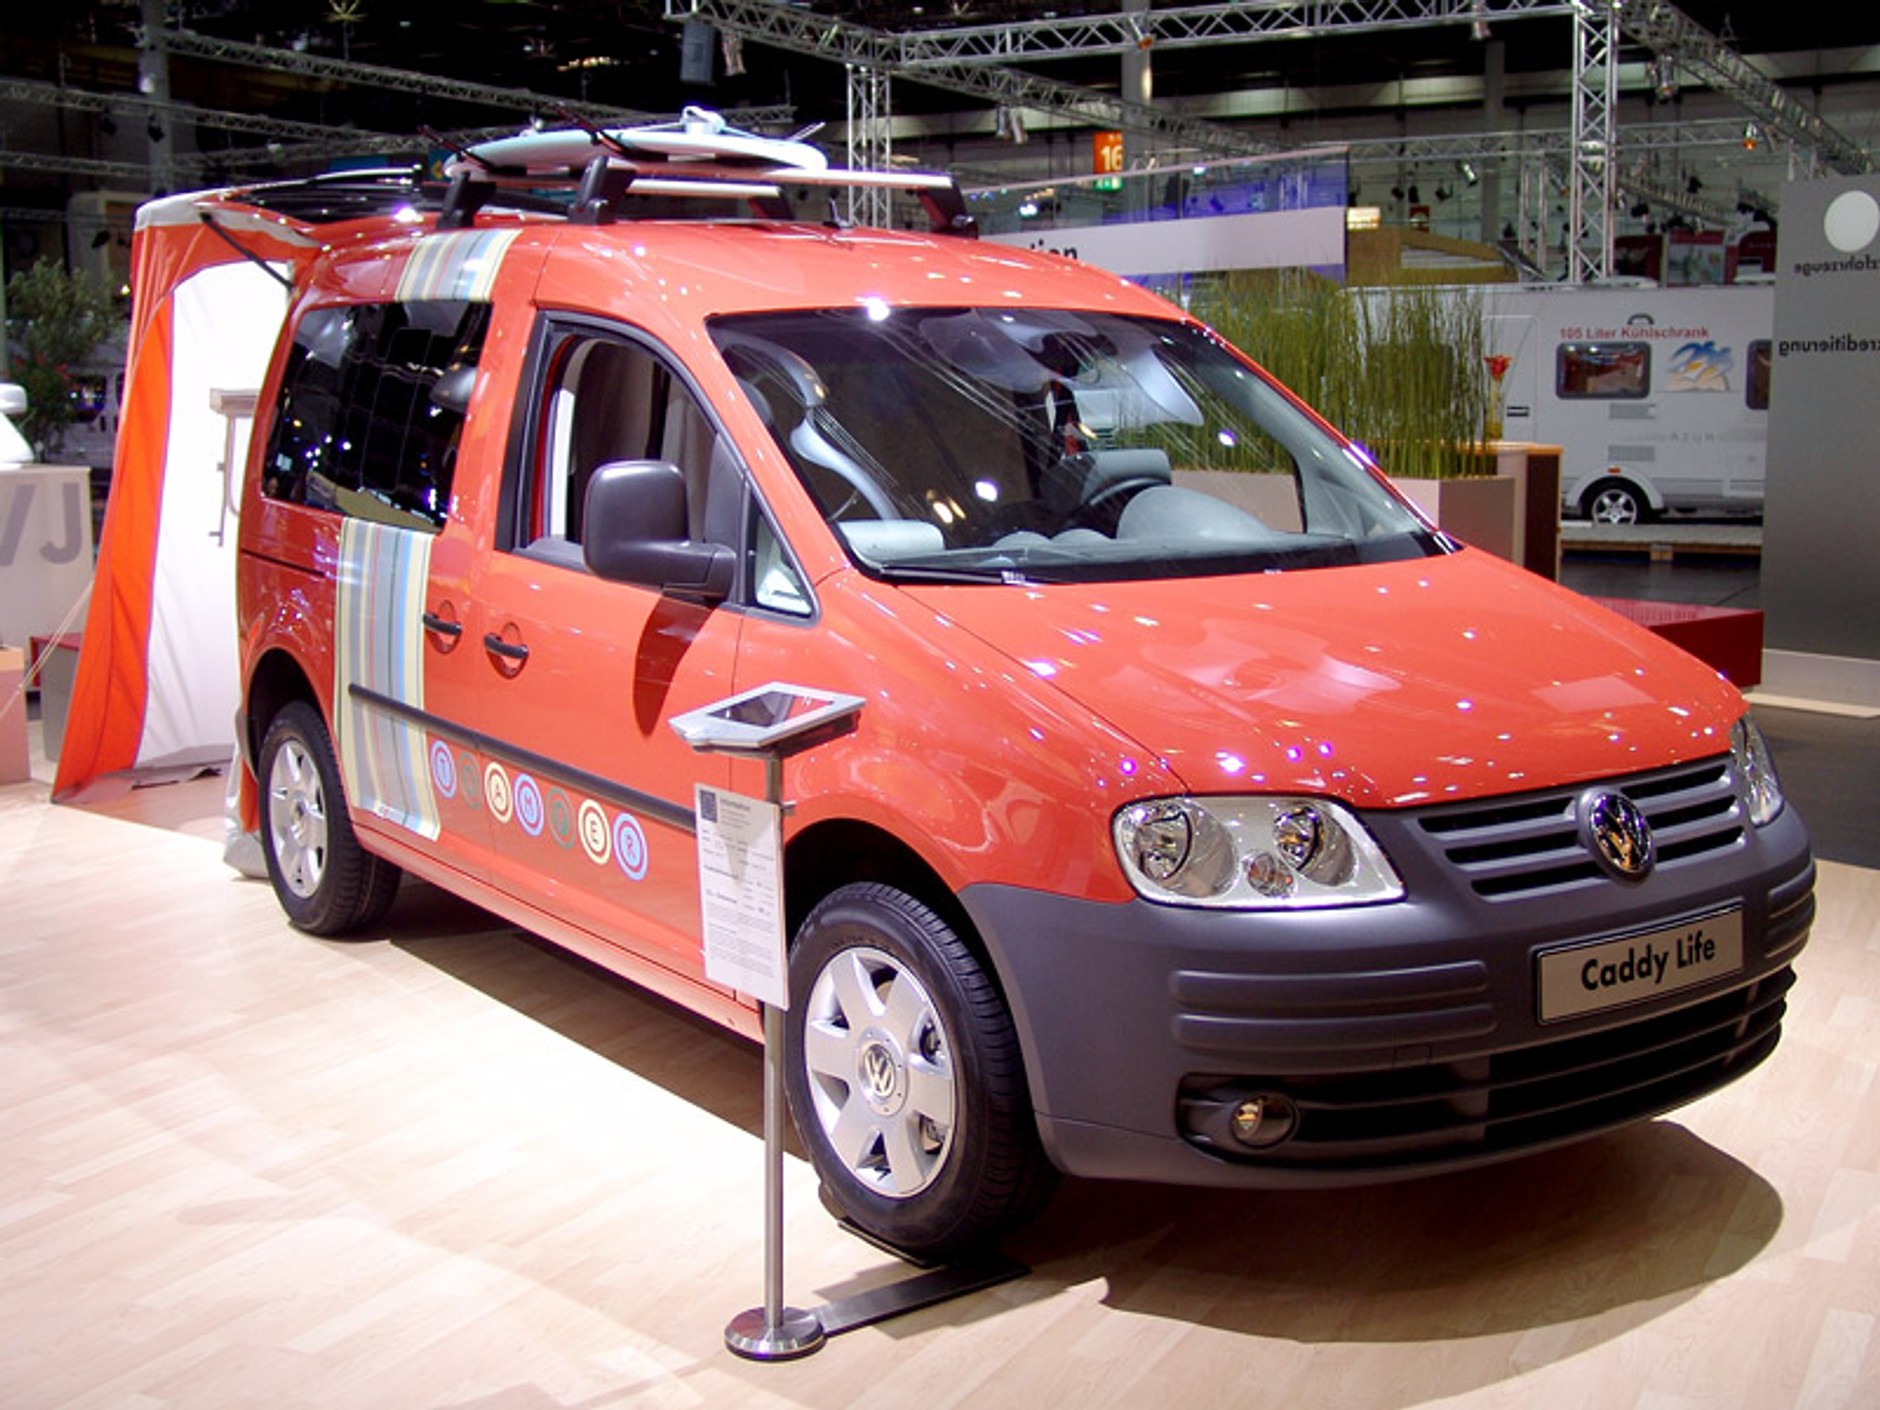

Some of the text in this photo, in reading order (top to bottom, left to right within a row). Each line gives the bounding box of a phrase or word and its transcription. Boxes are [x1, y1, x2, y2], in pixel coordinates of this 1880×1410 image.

[1100, 145, 1123, 171] 16
[1586, 327, 1616, 339] Liter
[1582, 931, 1716, 990] Caddy Life
